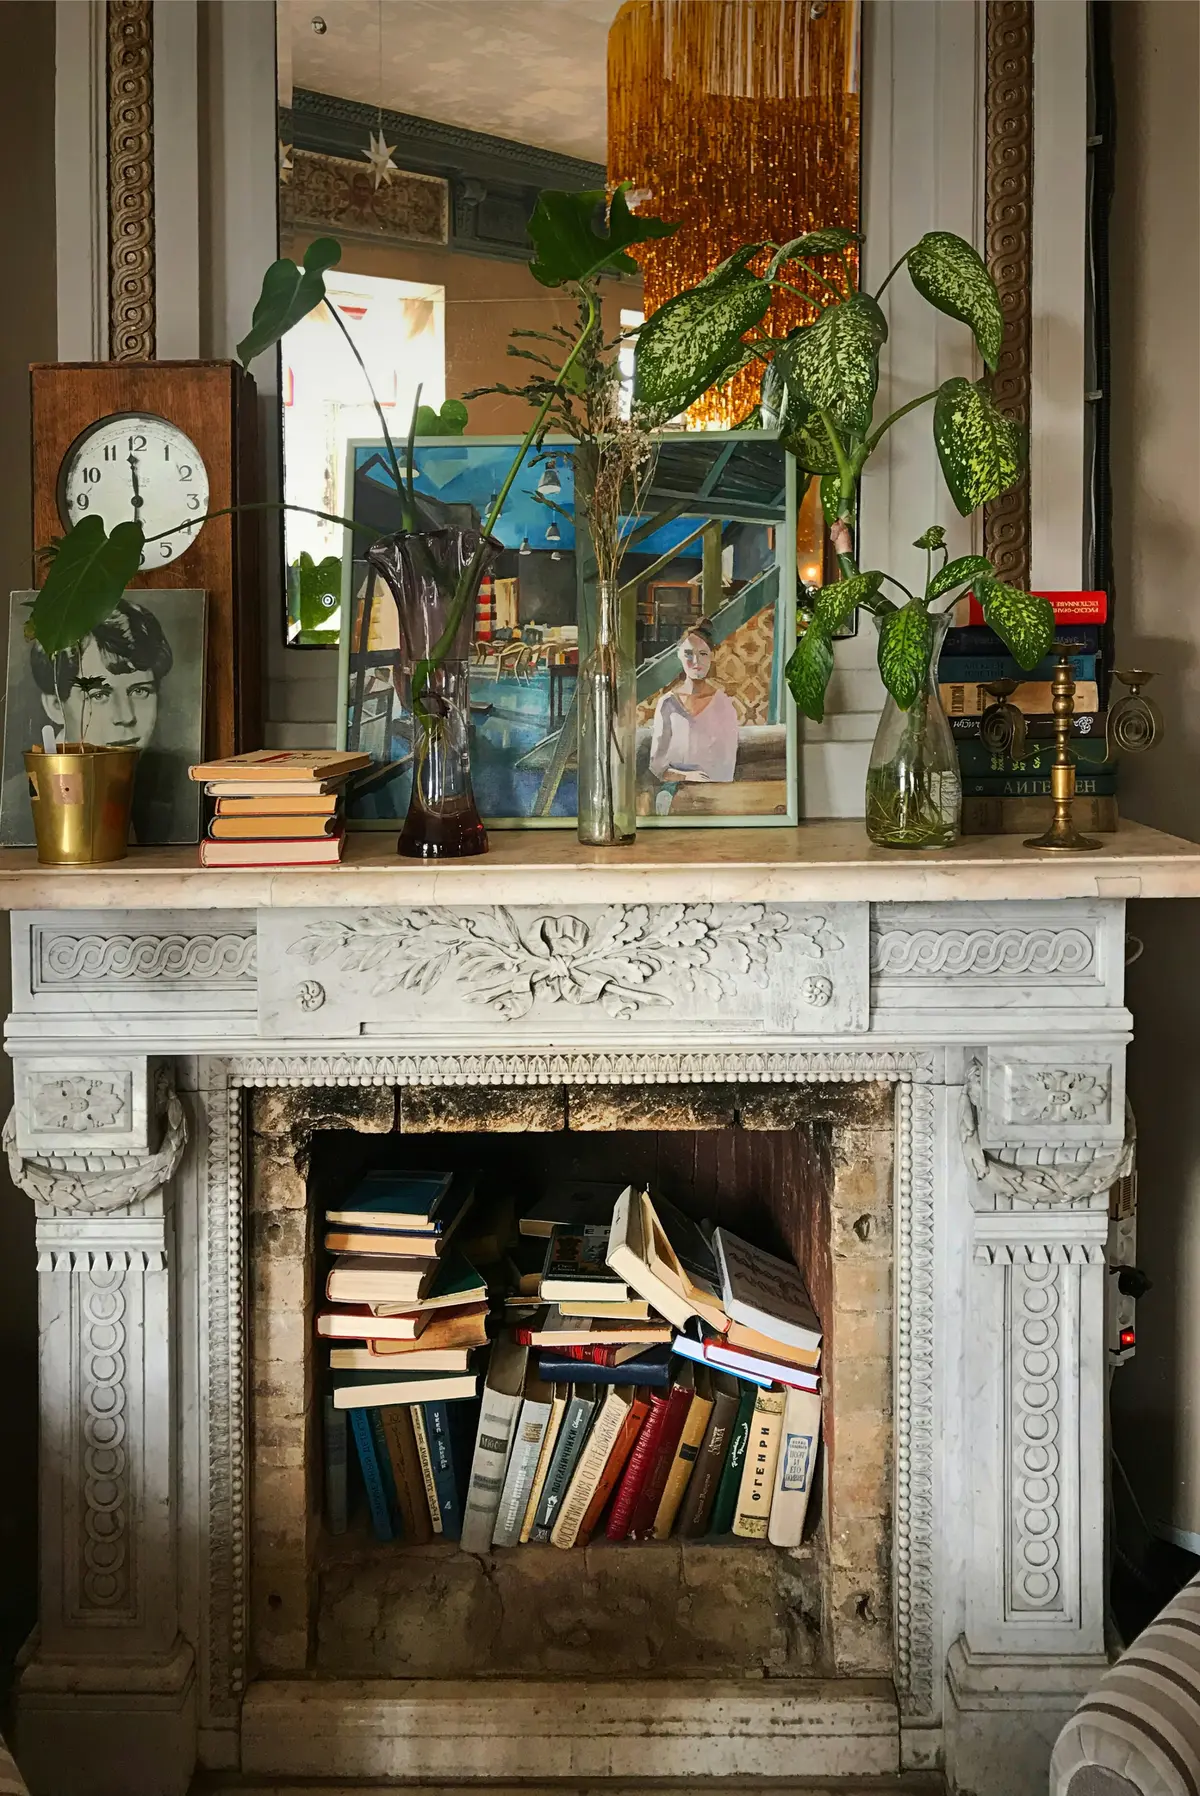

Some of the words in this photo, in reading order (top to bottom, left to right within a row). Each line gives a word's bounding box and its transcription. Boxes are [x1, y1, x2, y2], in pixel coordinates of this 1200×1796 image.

[127, 435, 147, 452] 12
[104, 444, 117, 461] 11
[164, 444, 170, 461] 1
[82, 467, 101, 484] 10
[178, 465, 193, 482] 2
[76, 493, 90, 510] 9
[186, 493, 200, 510] 3
[159, 542, 173, 558] 5
[1004, 780, 1097, 794] А.И.ГЕЕН
[552, 1429, 578, 1493] ПОГРАНИЧНИКИ
[752, 1427, 770, 1501] О'ГЕНРИ
[556, 1481, 594, 1547] ВОСПОМИНАНИЯ
[583, 1470, 597, 1481] О
